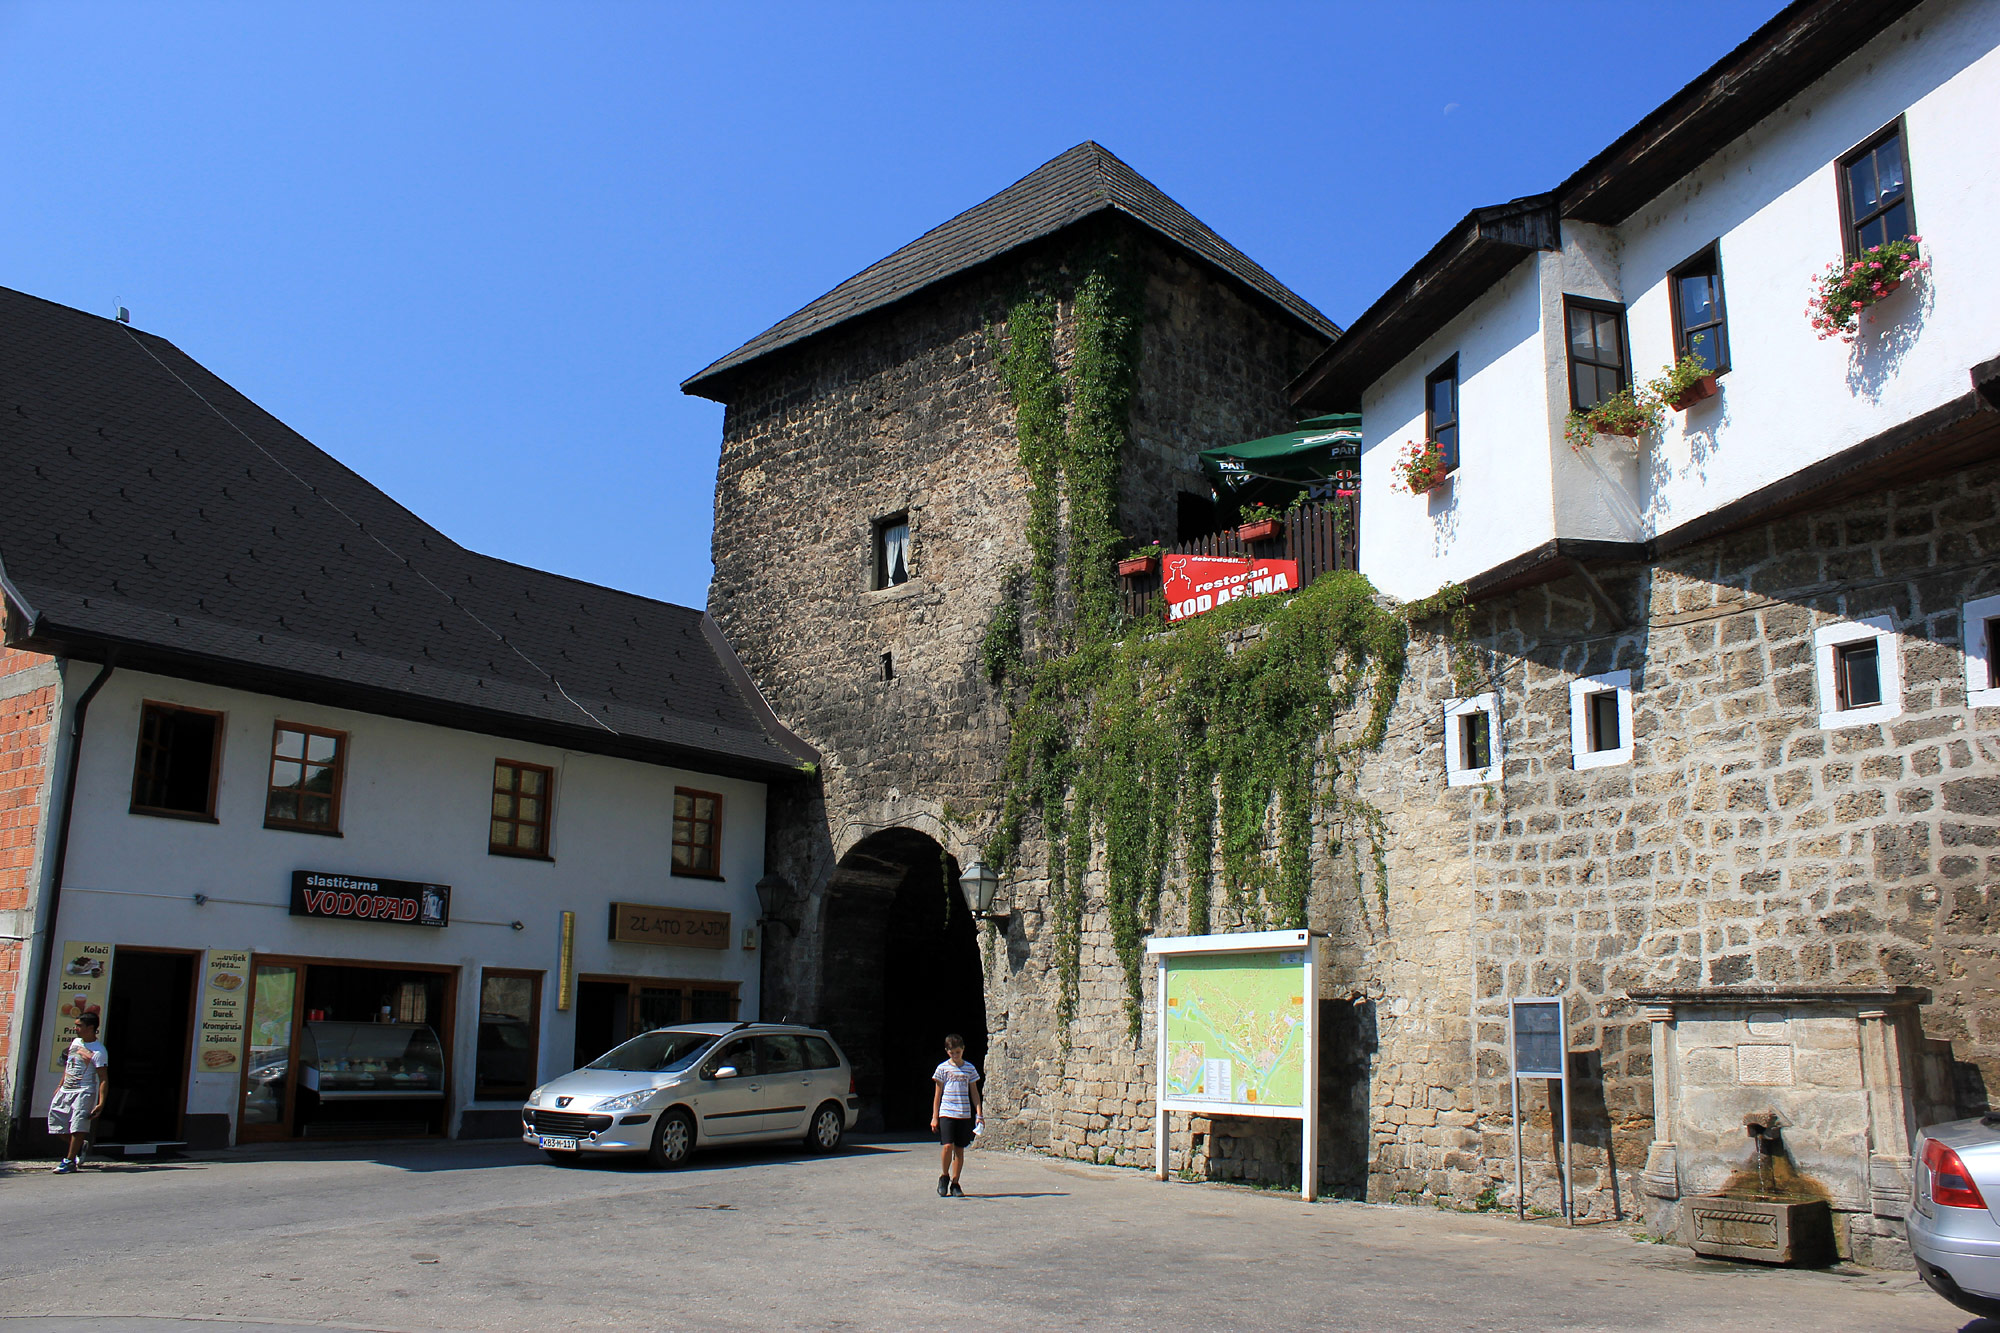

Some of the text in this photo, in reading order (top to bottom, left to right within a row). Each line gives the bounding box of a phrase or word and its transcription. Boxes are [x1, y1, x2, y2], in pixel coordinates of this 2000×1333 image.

[1332, 447, 1356, 456] PAN
[1195, 567, 1269, 592] restoran
[1169, 594, 1212, 620] KOD
[306, 875, 378, 891] slastičarna
[303, 889, 418, 921] VODOPAD
[630, 916, 681, 935] ZLATO
[84, 945, 109, 954] Kolači
[216, 954, 247, 962] ...uvijek
[62, 982, 91, 991] Sokovi
[212, 998, 237, 1006] Sirnica
[212, 1010, 233, 1018] Burek
[202, 1022, 242, 1031] Krompiruša
[205, 1035, 237, 1044] Zeljanica
